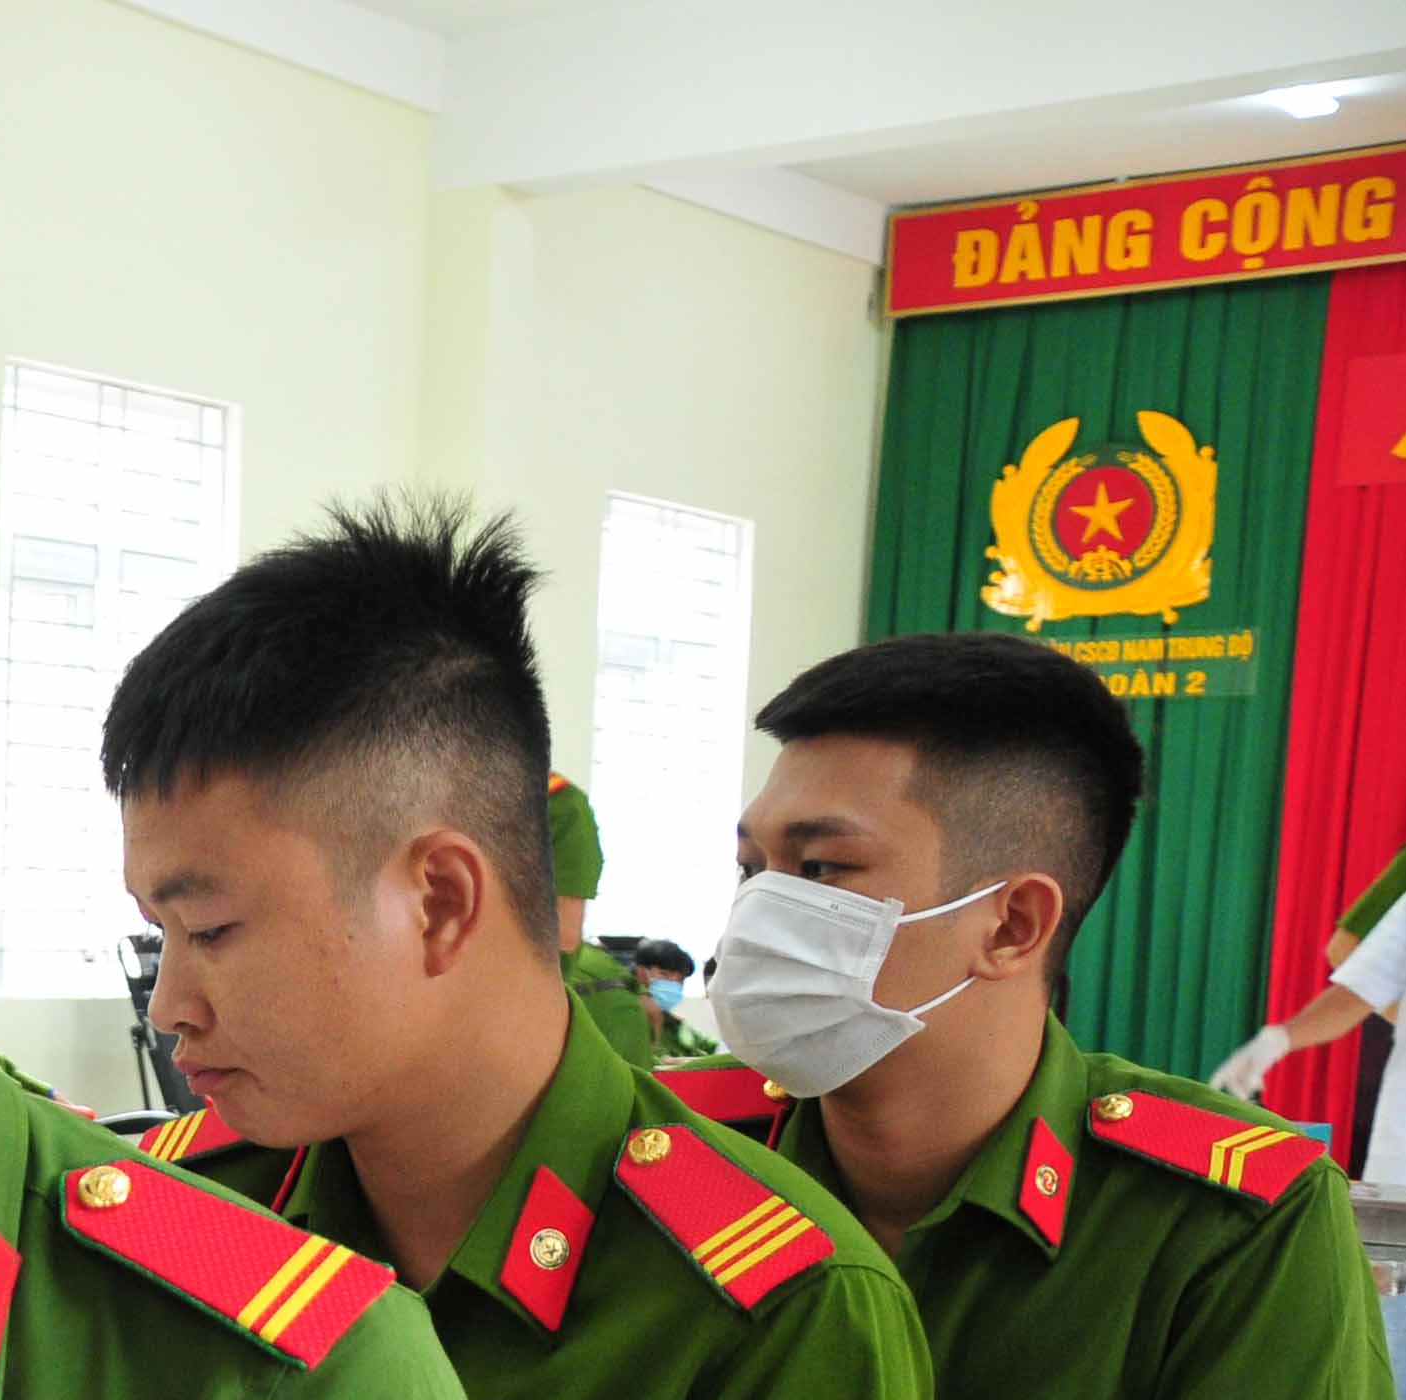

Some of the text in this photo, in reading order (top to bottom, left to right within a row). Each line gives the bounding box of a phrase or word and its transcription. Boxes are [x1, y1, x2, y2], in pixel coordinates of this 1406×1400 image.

[952, 175, 1396, 289] ĐẢNG CỘNG
[1099, 668, 1207, 696] OÀN 2
